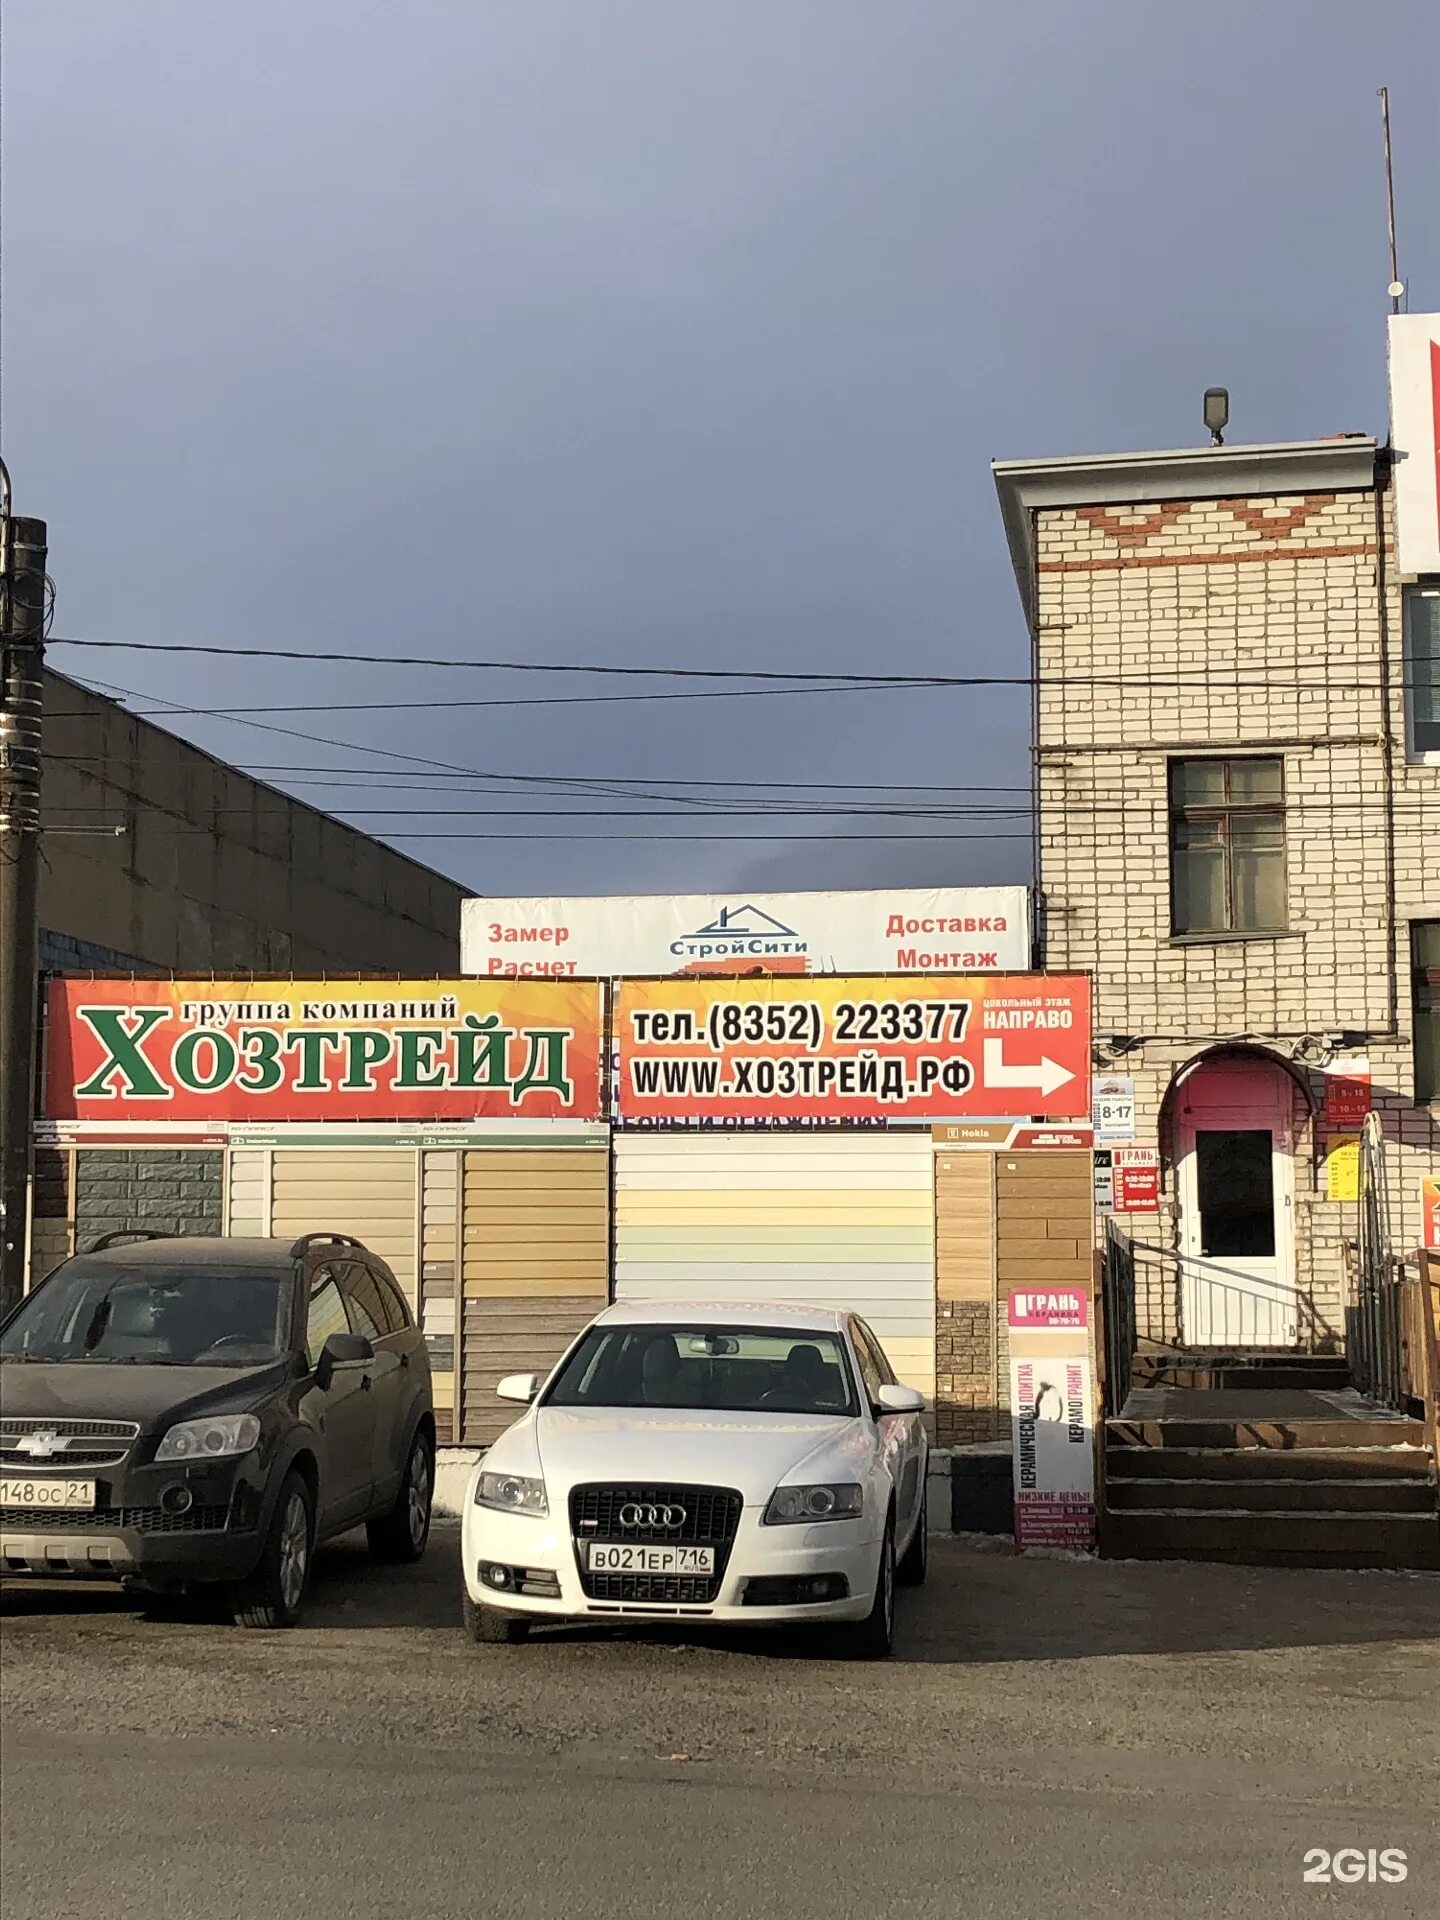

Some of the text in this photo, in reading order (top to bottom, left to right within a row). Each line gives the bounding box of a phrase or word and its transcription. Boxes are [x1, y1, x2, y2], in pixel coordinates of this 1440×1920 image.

[488, 923, 569, 946] Замер
[886, 914, 1008, 938] Доставка
[670, 940, 807, 958] СтройСити
[897, 948, 999, 968] Монтаж
[488, 957, 578, 975] Расчет
[182, 997, 457, 1025] группа компаний
[983, 996, 1072, 1008] цокольный этаж
[835, 1002, 969, 1040] 223377
[983, 1010, 1073, 1029] НАПРАВО
[75, 1014, 574, 1105] ХОЗТРЕЙД
[633, 1053, 972, 1099] WWW.ХОЗТРЕЙД.РФ
[1102, 1105, 1132, 1119] 8-17
[1122, 1151, 1153, 1160] ГРАНЬ
[1027, 1294, 1080, 1310] ГРАНЬ
[1066, 1364, 1085, 1444] КЕРАМОГРАНИТ
[1018, 1363, 1037, 1489] КЕРАМИЧЕСКАЯ ПЛИТКА
[1018, 1491, 1091, 1503] НИЗКИЕ ЦЕНЫ!
